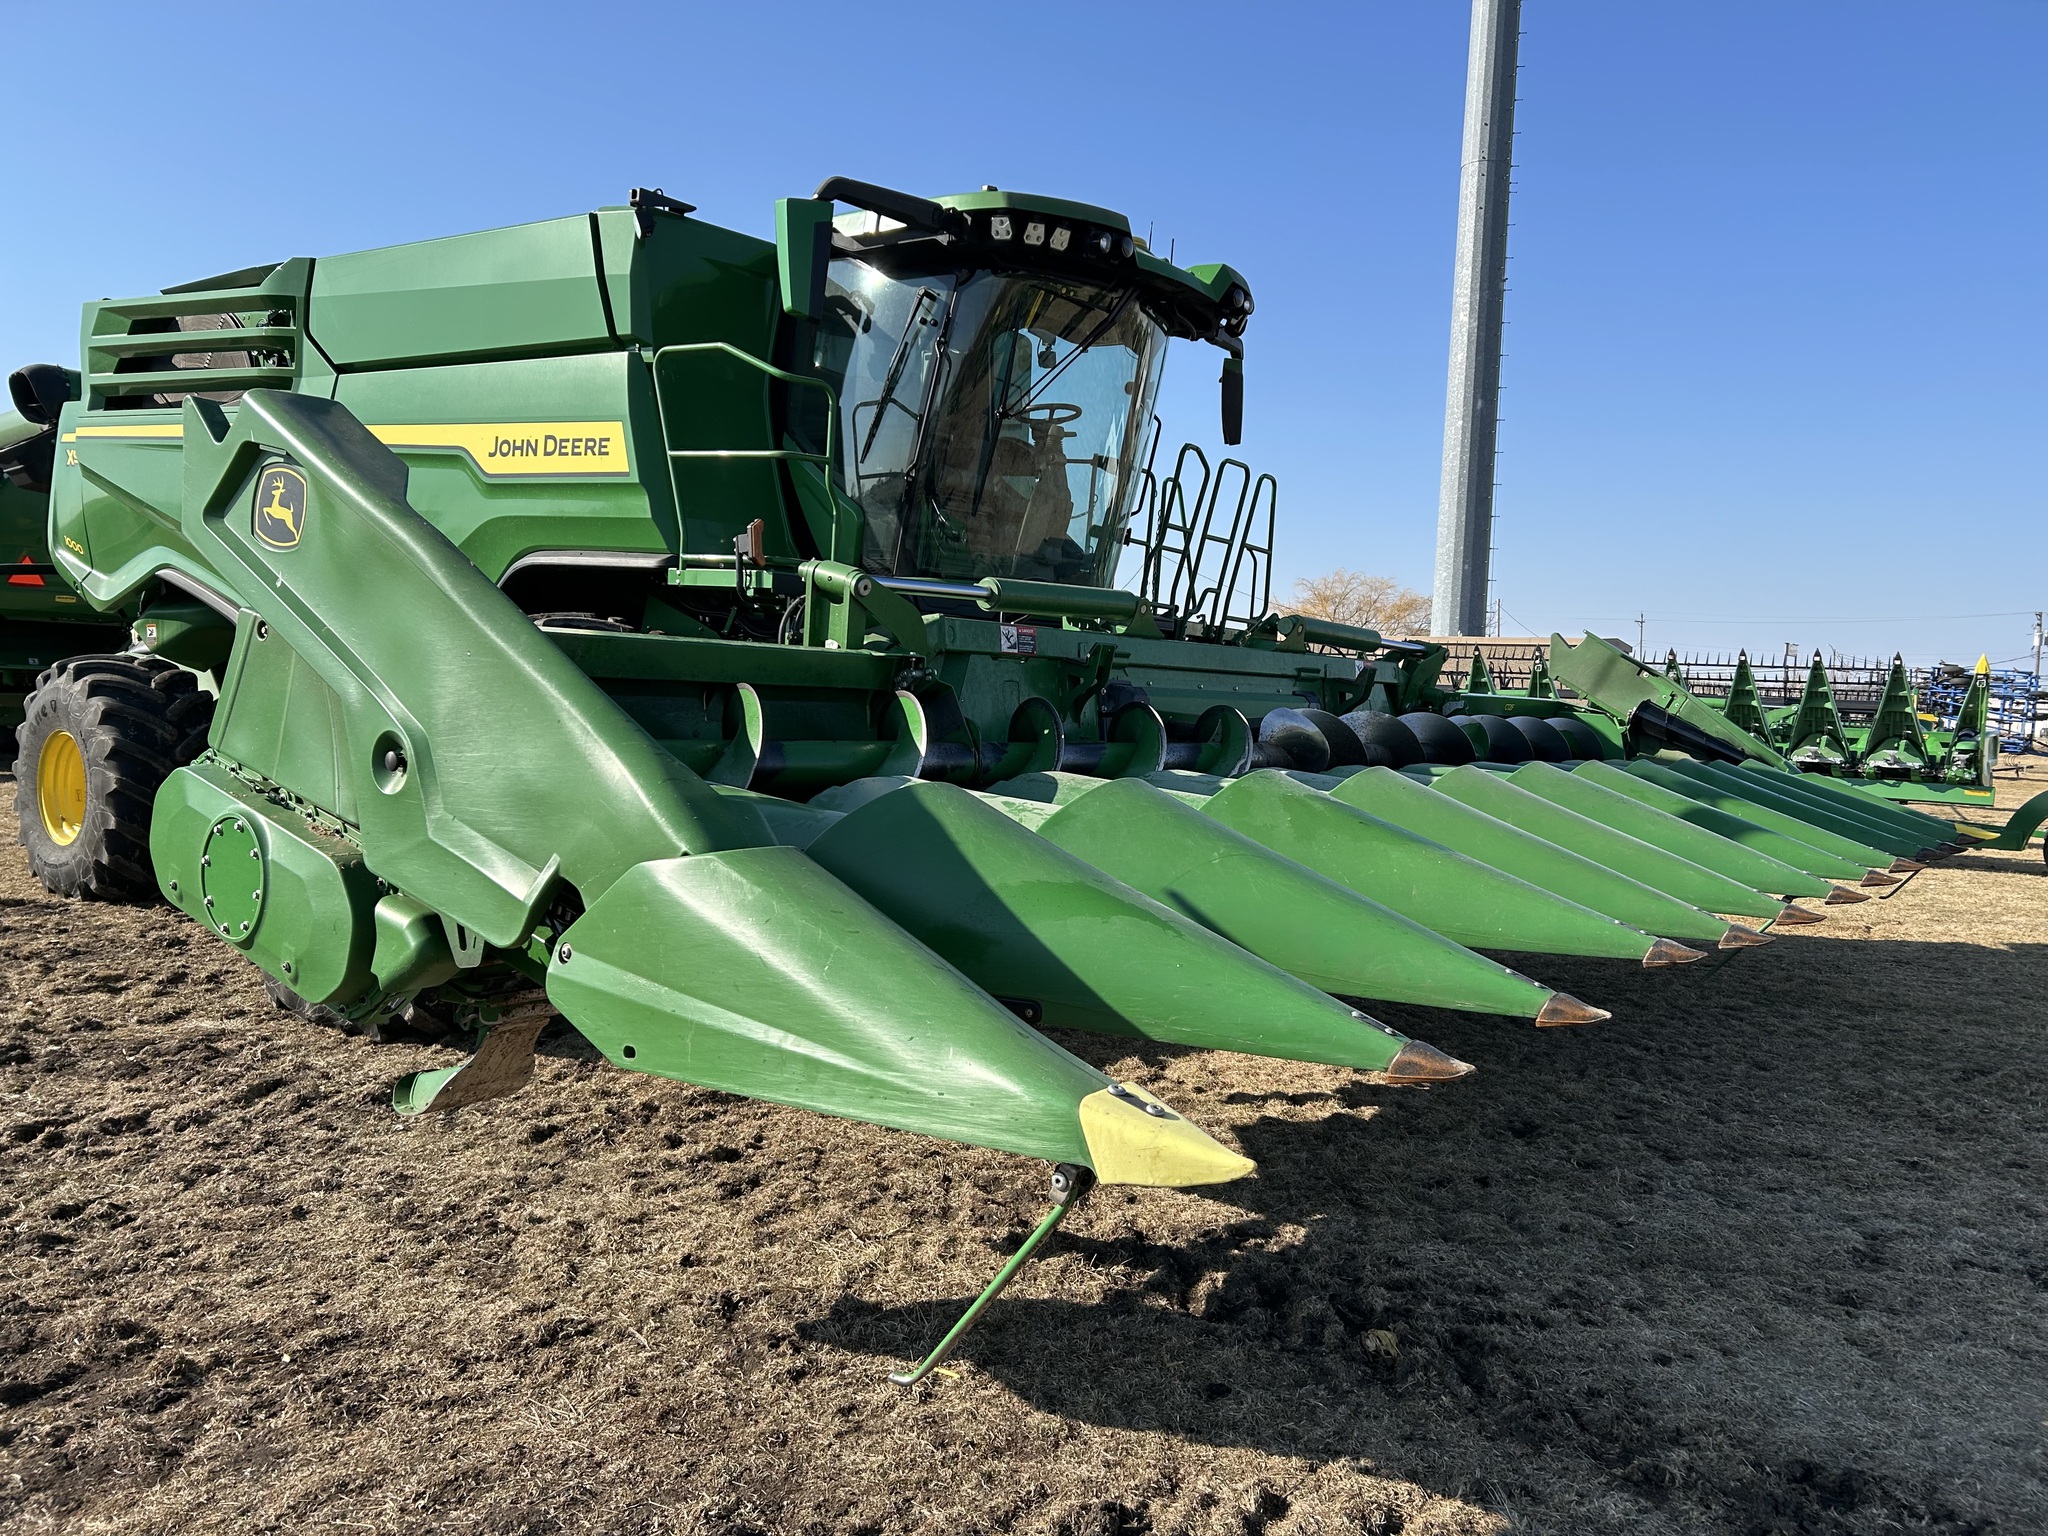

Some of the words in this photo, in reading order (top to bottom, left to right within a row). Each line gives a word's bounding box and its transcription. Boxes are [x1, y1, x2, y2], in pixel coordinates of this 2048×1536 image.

[488, 436, 538, 457] JOHN
[543, 434, 610, 456] DEERE
[63, 535, 84, 554] 1000
